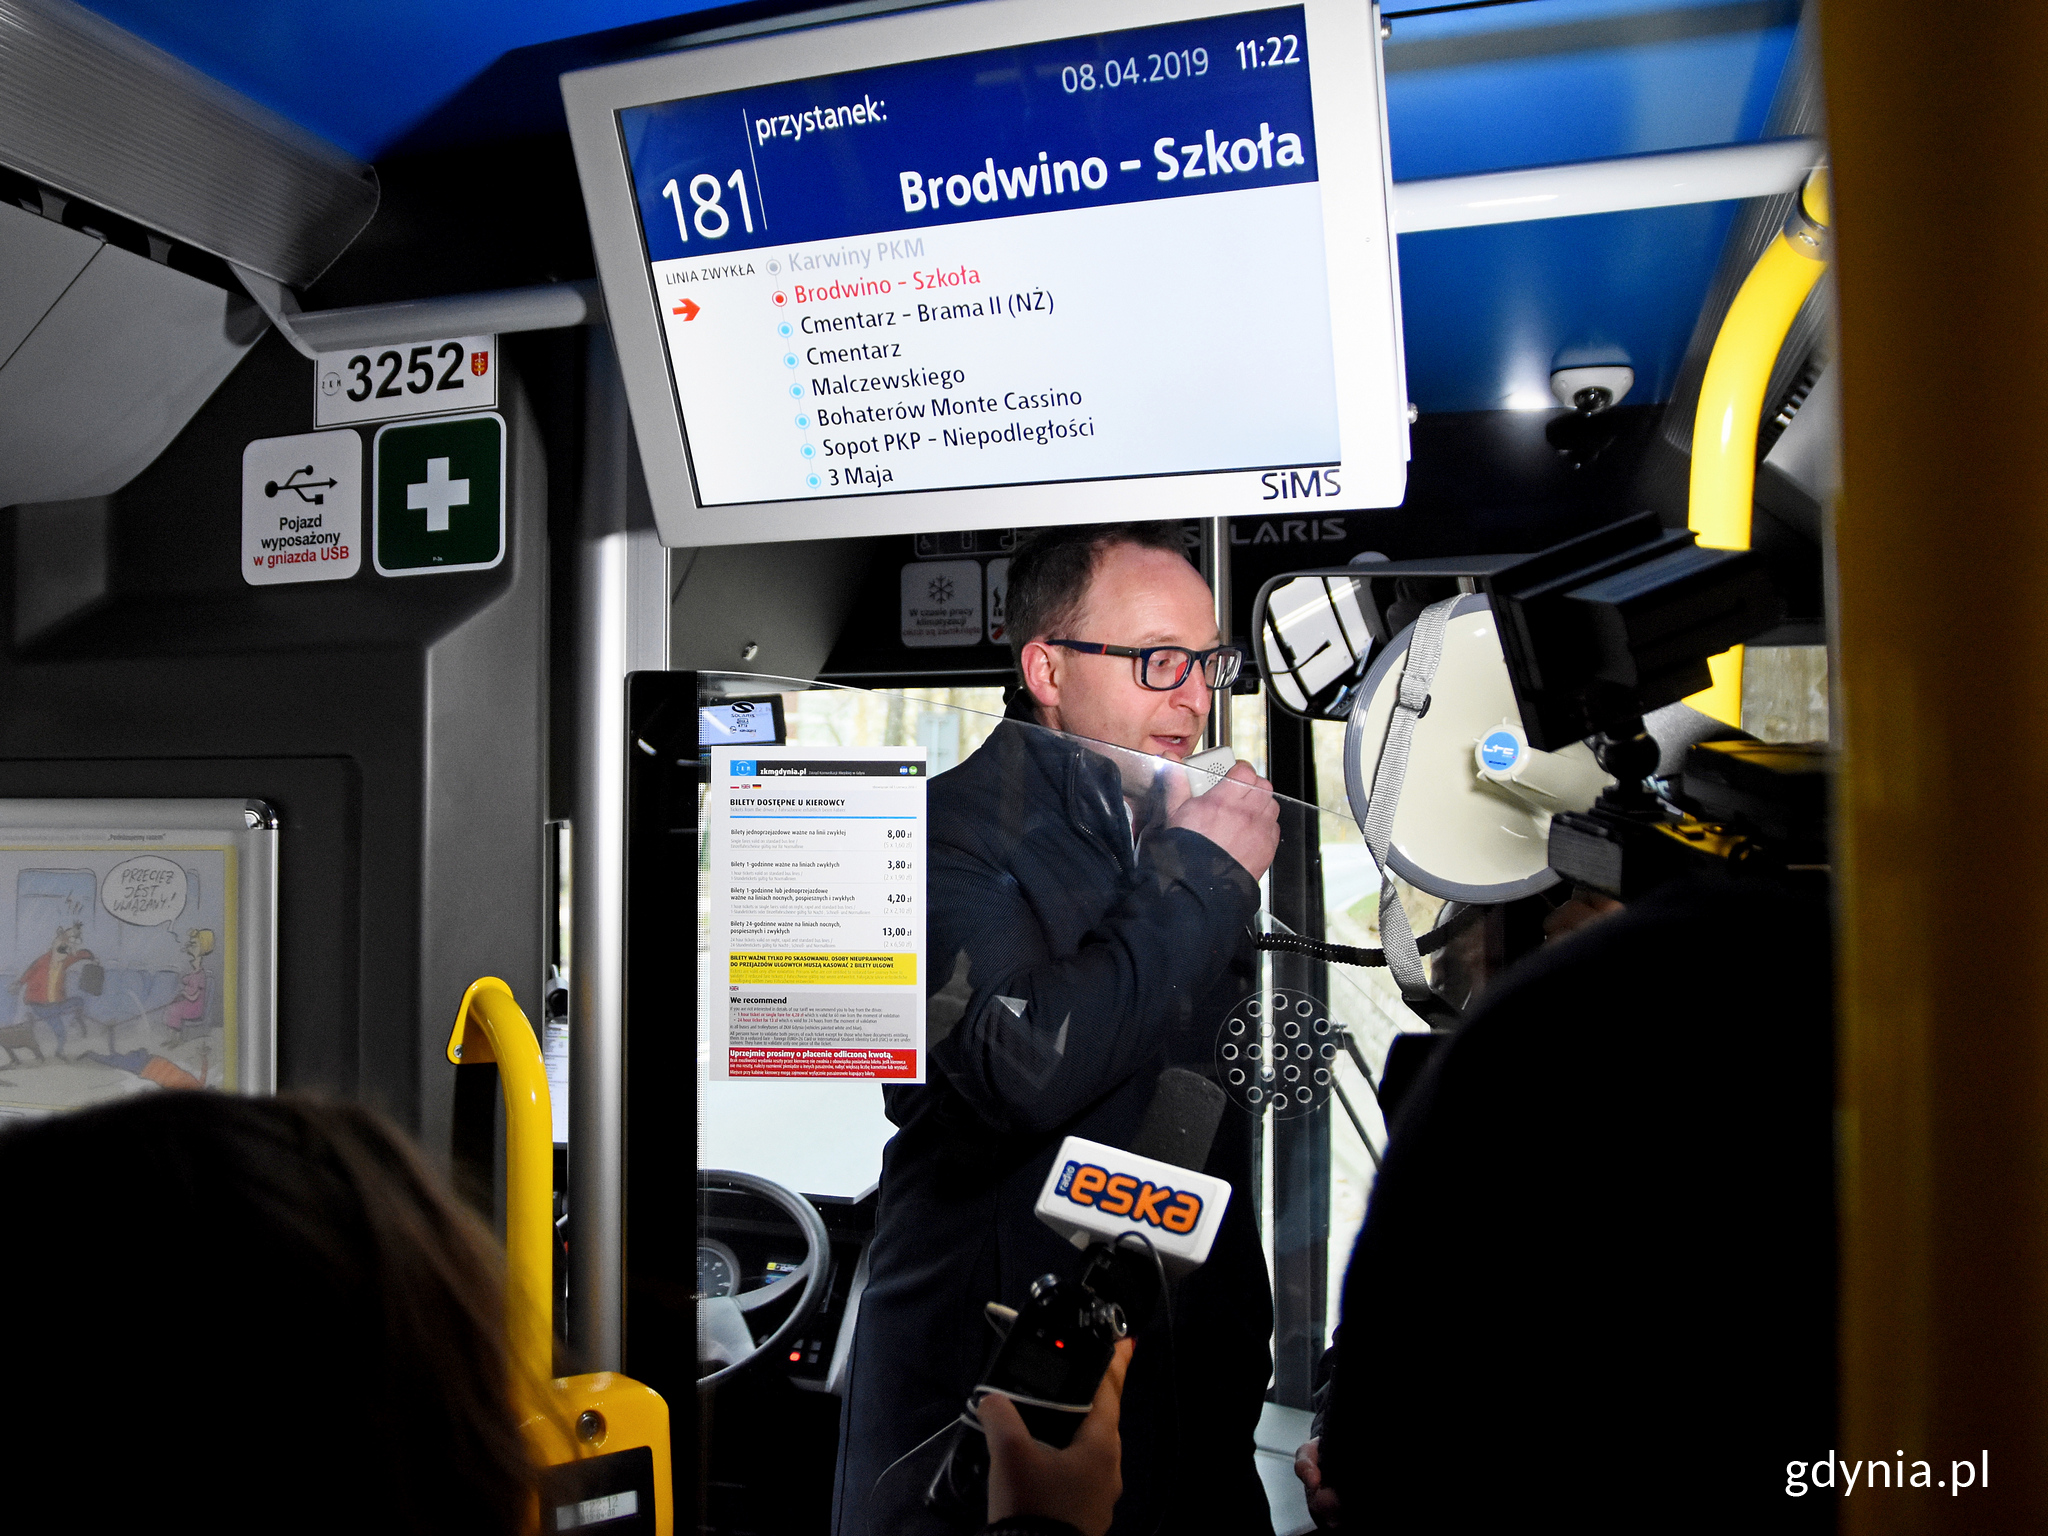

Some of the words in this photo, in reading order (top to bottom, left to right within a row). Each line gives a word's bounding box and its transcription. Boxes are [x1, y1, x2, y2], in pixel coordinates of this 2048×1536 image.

[1236, 34, 1300, 71] 11:22
[1061, 47, 1210, 93] 08.04.2019
[755, 94, 888, 146] przystanek:
[899, 151, 1108, 213] Brodwino
[1153, 122, 1305, 181] Szkoła
[662, 168, 753, 242] 181
[788, 244, 871, 273] Karwiny
[877, 237, 925, 262] PKM
[665, 271, 698, 286] LINIA
[701, 262, 755, 281] ZWYKŁA
[794, 276, 891, 304] Brodwino
[913, 264, 981, 290] Szkoła
[800, 309, 896, 335] Cmentarz
[917, 297, 984, 323] Brama
[989, 296, 1002, 315] II
[1008, 285, 1055, 318] (NŻ)
[806, 341, 902, 366] Cmentarz
[346, 341, 465, 402] 3252
[811, 366, 966, 397] Malczewskiego
[817, 401, 926, 427] Bohaterów
[931, 394, 998, 417] Monte
[1003, 387, 1083, 411] Cassino
[822, 433, 880, 460] Sopot
[884, 432, 921, 453] PKP
[942, 417, 1096, 450] Niepodległości
[828, 468, 840, 487] 3
[844, 464, 894, 488] Maja
[1260, 468, 1342, 501] SiMS
[279, 514, 322, 531] Pojazd
[261, 531, 340, 551] wyposażony
[253, 556, 264, 566] w
[267, 550, 317, 568] gniazda
[320, 545, 349, 561] USB
[760, 767, 807, 776] zkmgdynia.pl
[887, 829, 905, 839] 8,00
[887, 860, 905, 870] 3,80
[124, 884, 161, 899] JEST
[887, 893, 905, 903] 4,20
[883, 927, 905, 937] 13,00
[730, 1049, 765, 1059] Uprzejmie
[766, 1050, 795, 1059] prosimy
[833, 1050, 867, 1060] odliczoną
[868, 1051, 893, 1060] kwotą.
[1059, 1164, 1076, 1192] radio
[1070, 1165, 1201, 1233] eska
